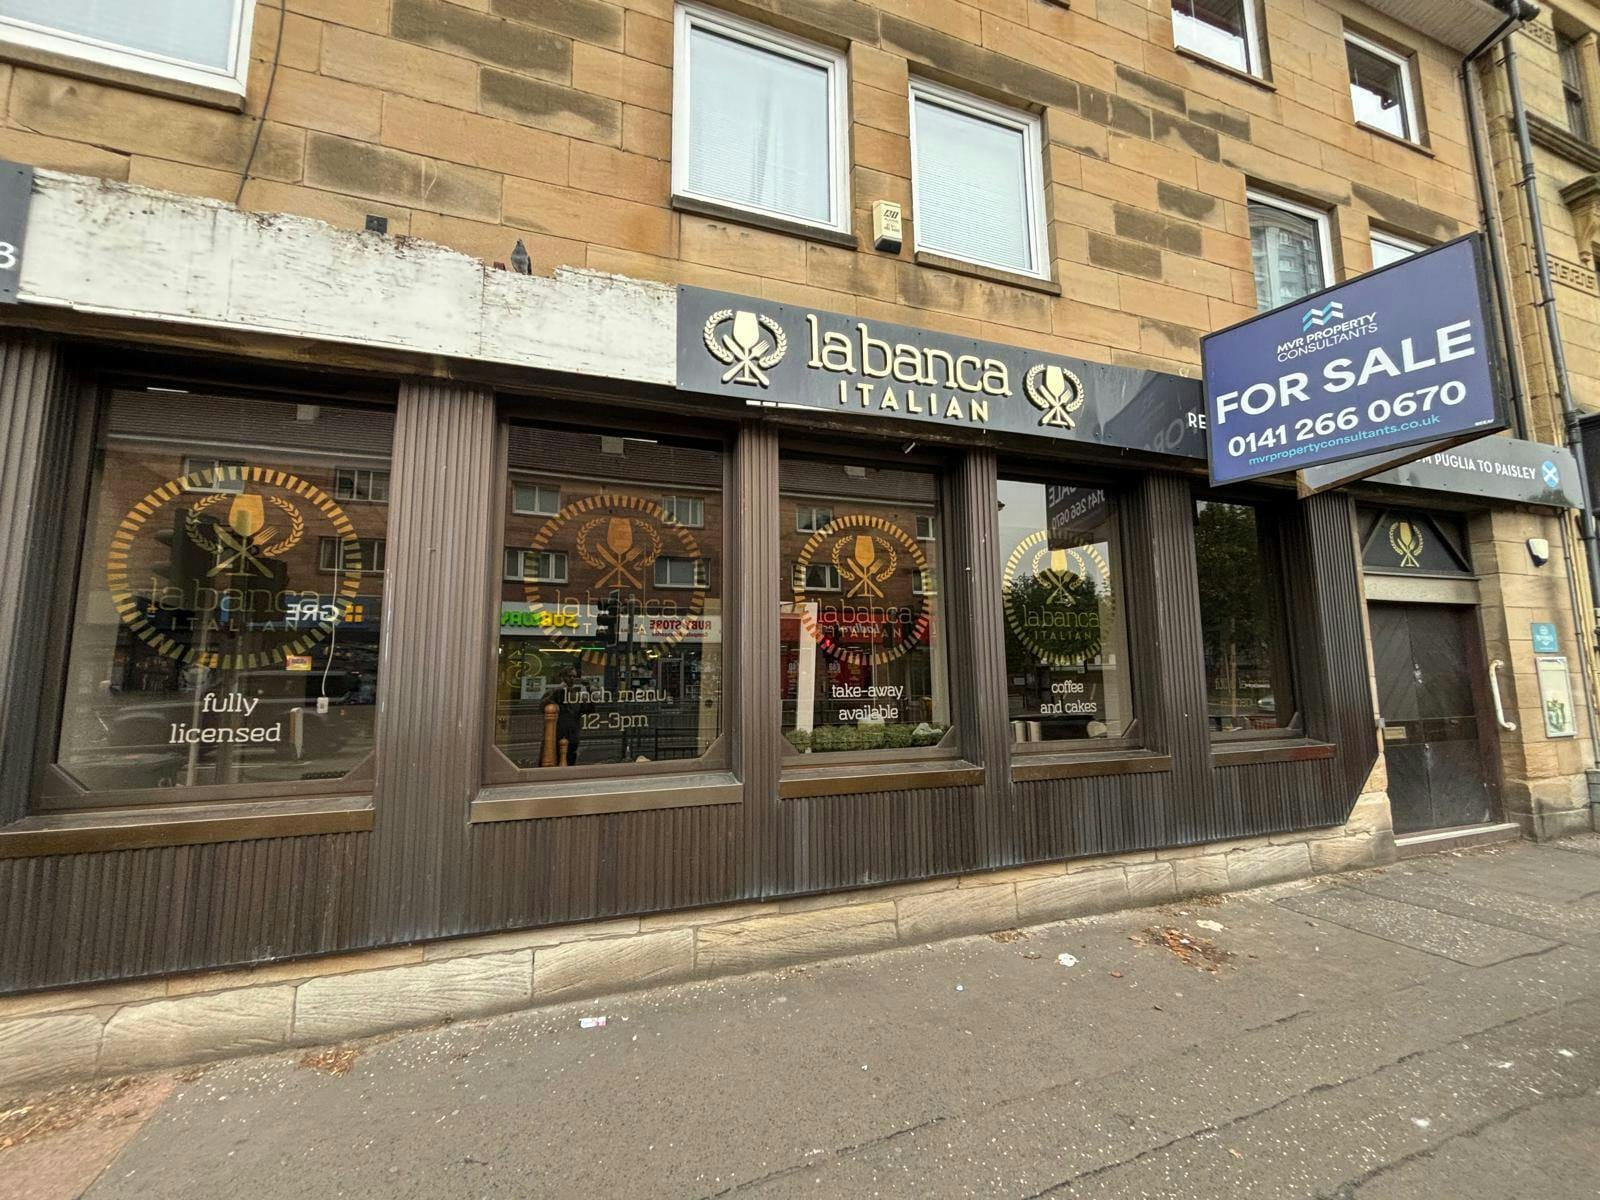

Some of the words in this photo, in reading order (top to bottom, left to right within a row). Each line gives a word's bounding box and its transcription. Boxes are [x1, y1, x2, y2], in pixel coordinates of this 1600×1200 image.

[1277, 337, 1304, 354] MVR
[1306, 312, 1377, 342] PROPERTY
[1277, 322, 1378, 363] CONSULTANTS
[1216, 372, 1311, 424] FOR
[1323, 320, 1475, 393] SALE
[839, 380, 989, 422] ITALIAN
[1228, 424, 1287, 457] 0141
[1295, 407, 1359, 441] 266
[1367, 381, 1466, 423] 0670
[1249, 413, 1440, 465] mvrpropertyconsultants.co.uk
[1434, 452, 1476, 472] PUGLIA
[1476, 459, 1493, 474] TO
[1494, 462, 1536, 480] PAISLEY
[1034, 631, 1092, 641] ITALIAN
[563, 687, 612, 704] lunch
[618, 688, 668, 703] menu
[831, 683, 904, 700] take-away
[1051, 680, 1084, 694] coffee
[202, 693, 259, 717] fully
[838, 704, 899, 721] available
[1040, 700, 1062, 714] and
[1065, 699, 1097, 714] cakes
[581, 712, 649, 731] 12-3pm
[169, 723, 281, 744] licensed
